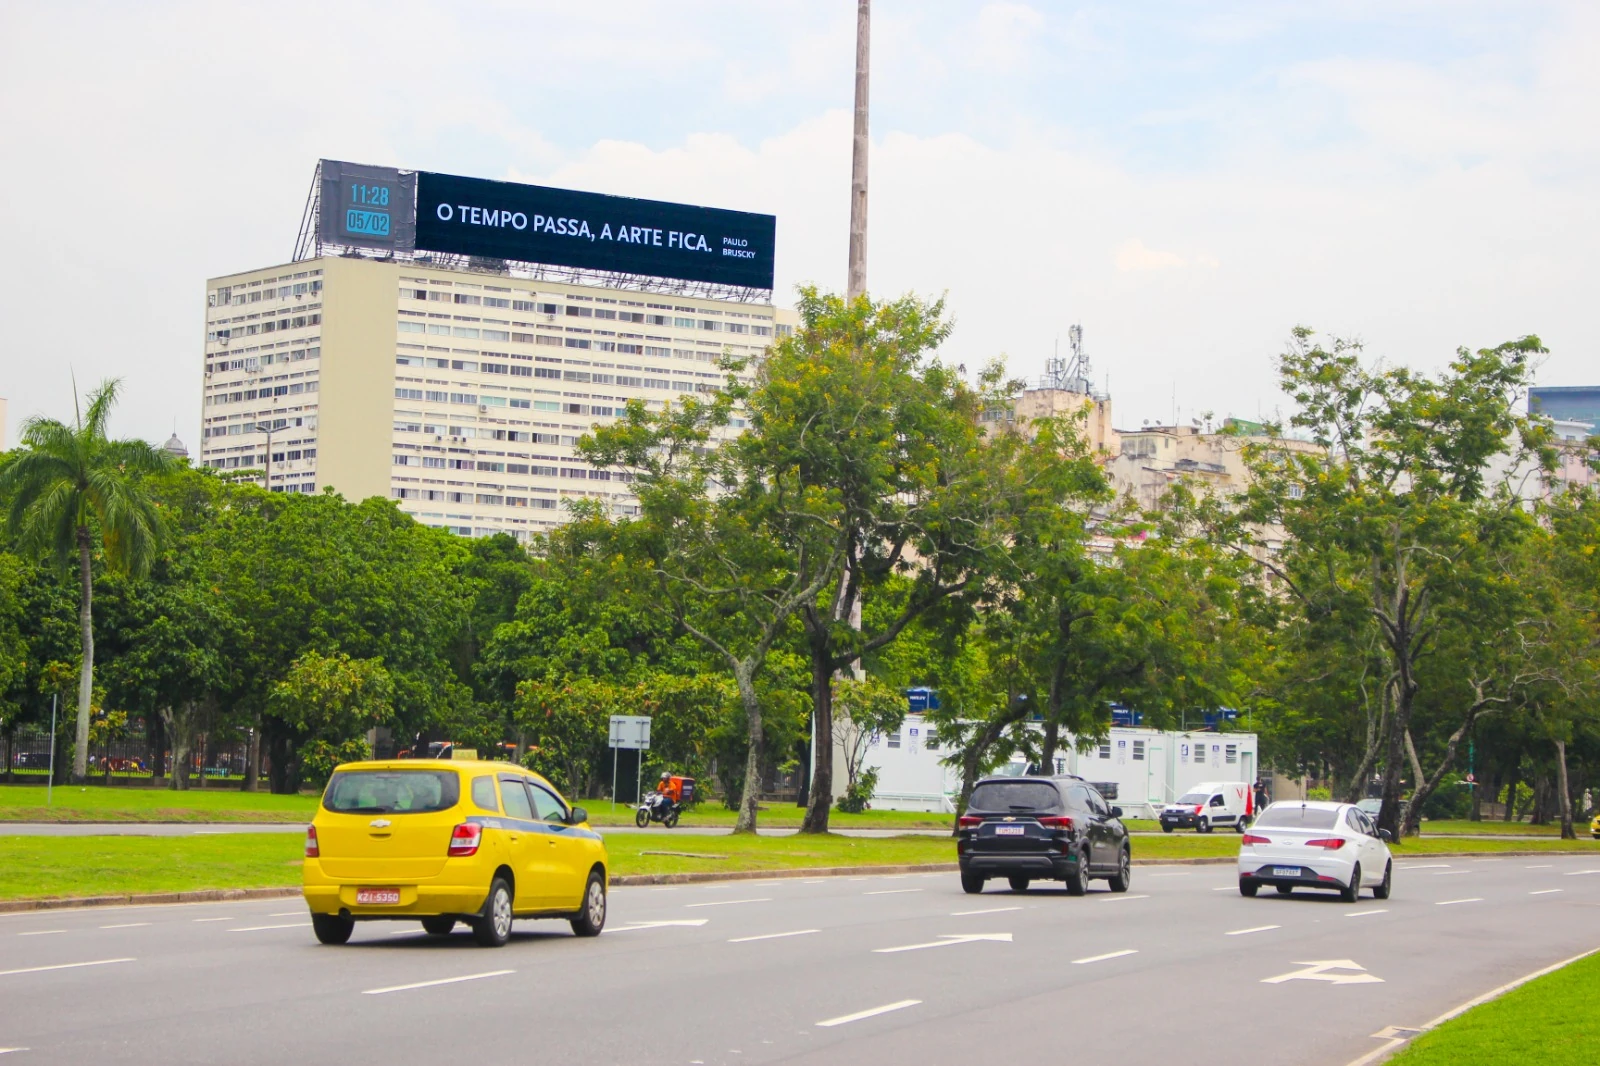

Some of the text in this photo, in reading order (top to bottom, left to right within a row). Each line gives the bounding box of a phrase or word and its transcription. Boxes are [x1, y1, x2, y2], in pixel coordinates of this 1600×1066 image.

[351, 183, 389, 206] 11:28
[348, 212, 388, 232] 05/02
[436, 203, 713, 253] O TEMPO PASSA, A ARTE FICA.
[723, 237, 748, 247] PAULO
[722, 248, 756, 259] BRUSCKY
